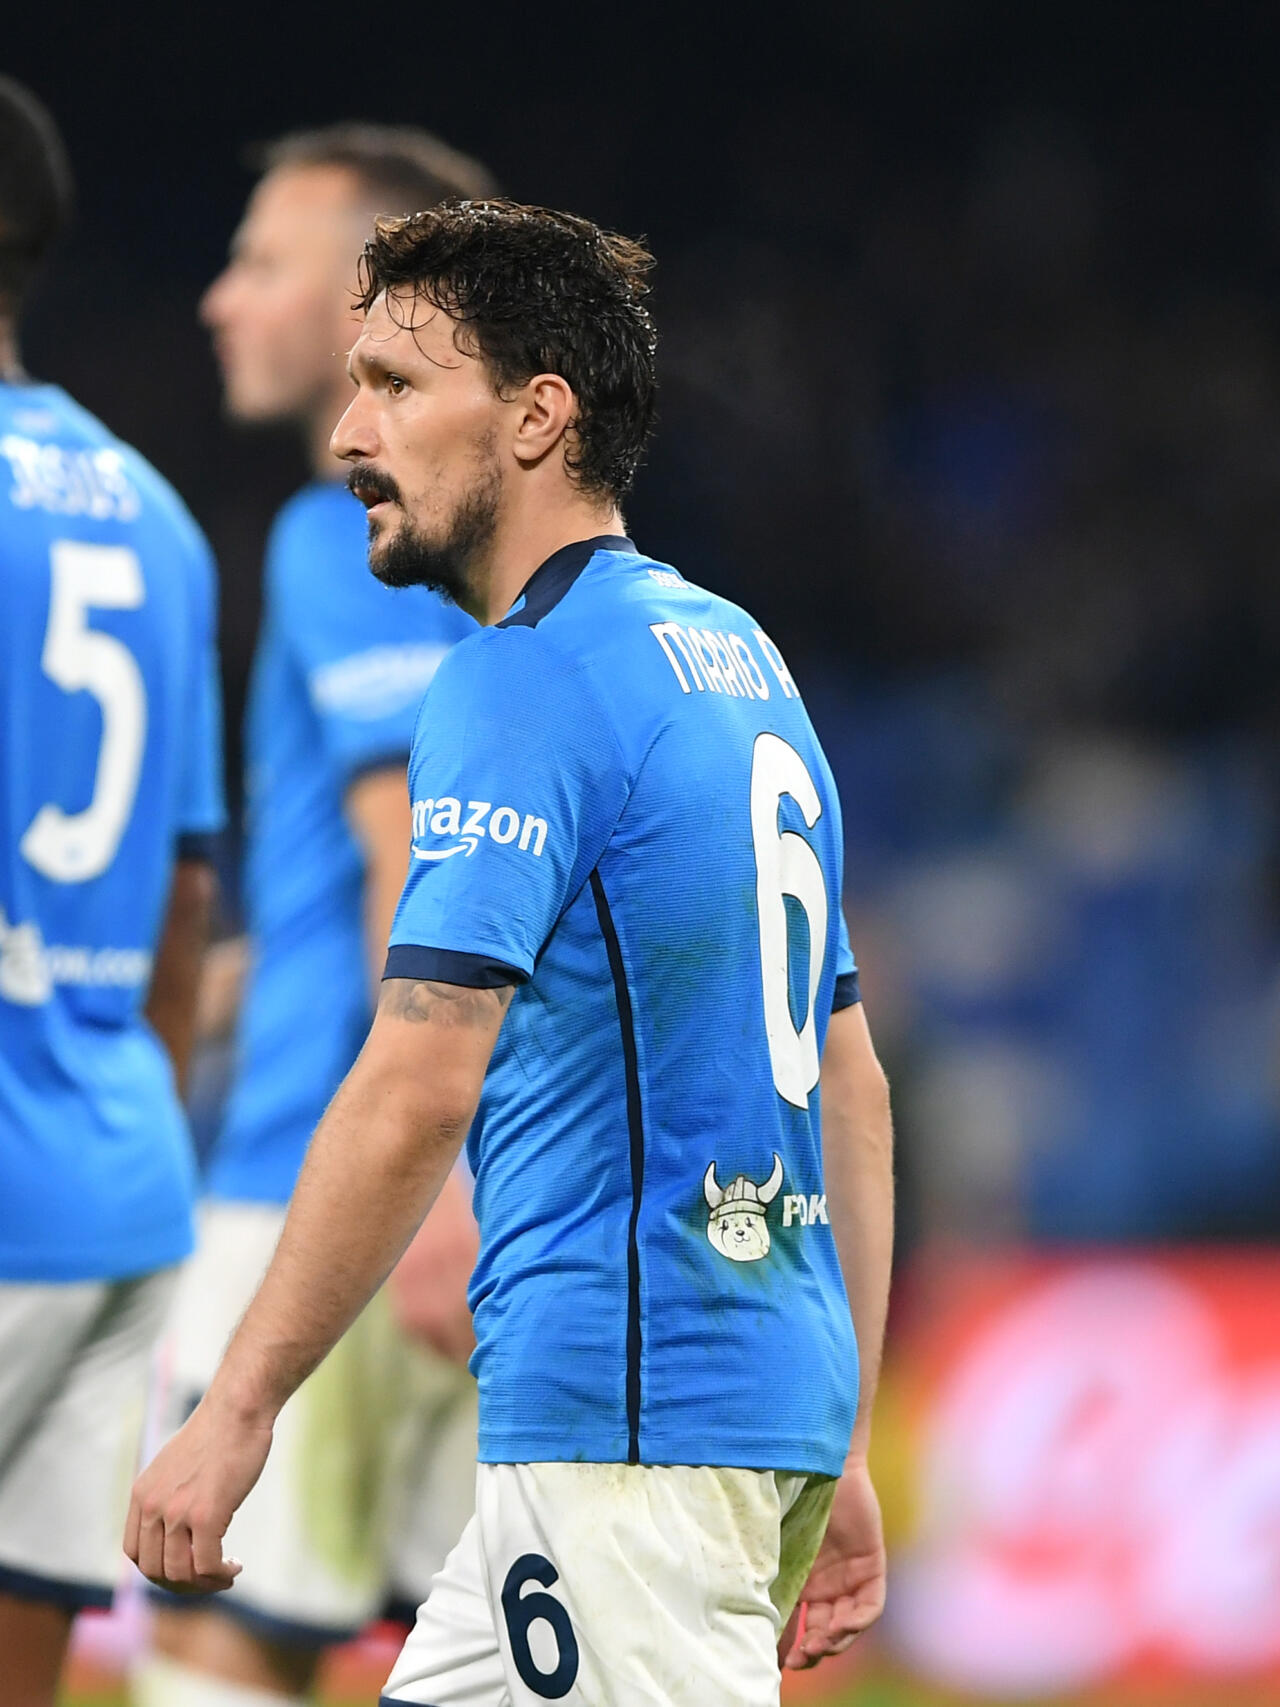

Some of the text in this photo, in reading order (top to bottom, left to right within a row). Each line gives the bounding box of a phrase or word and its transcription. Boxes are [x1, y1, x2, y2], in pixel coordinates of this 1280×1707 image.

[21, 539, 147, 883] 5
[648, 621, 771, 701] MARIO
[750, 731, 829, 1111] 6
[501, 1553, 579, 1699] 6
